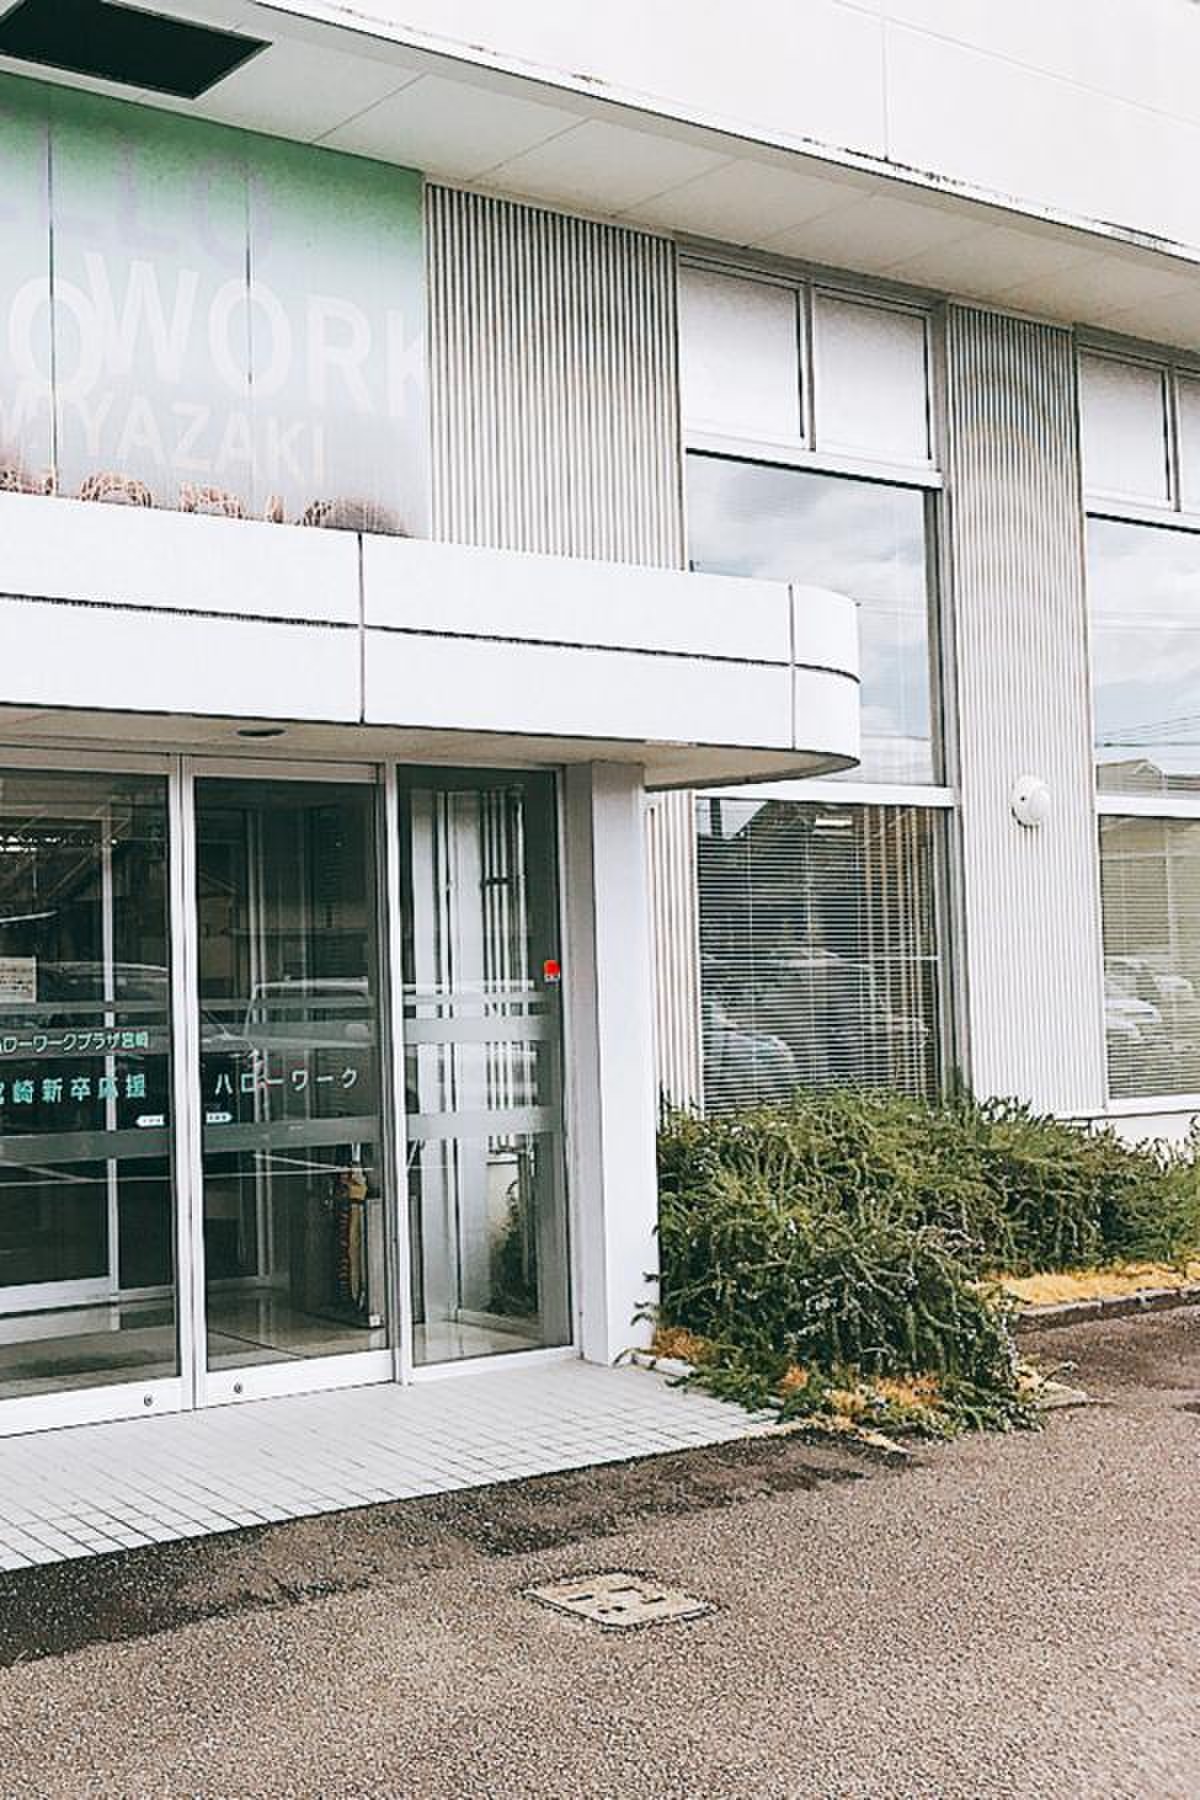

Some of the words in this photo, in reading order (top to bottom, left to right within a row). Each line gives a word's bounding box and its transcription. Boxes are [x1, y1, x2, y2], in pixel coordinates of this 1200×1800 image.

[84, 250, 426, 417] WORK
[214, 1067, 359, 1096] ハローワーク
